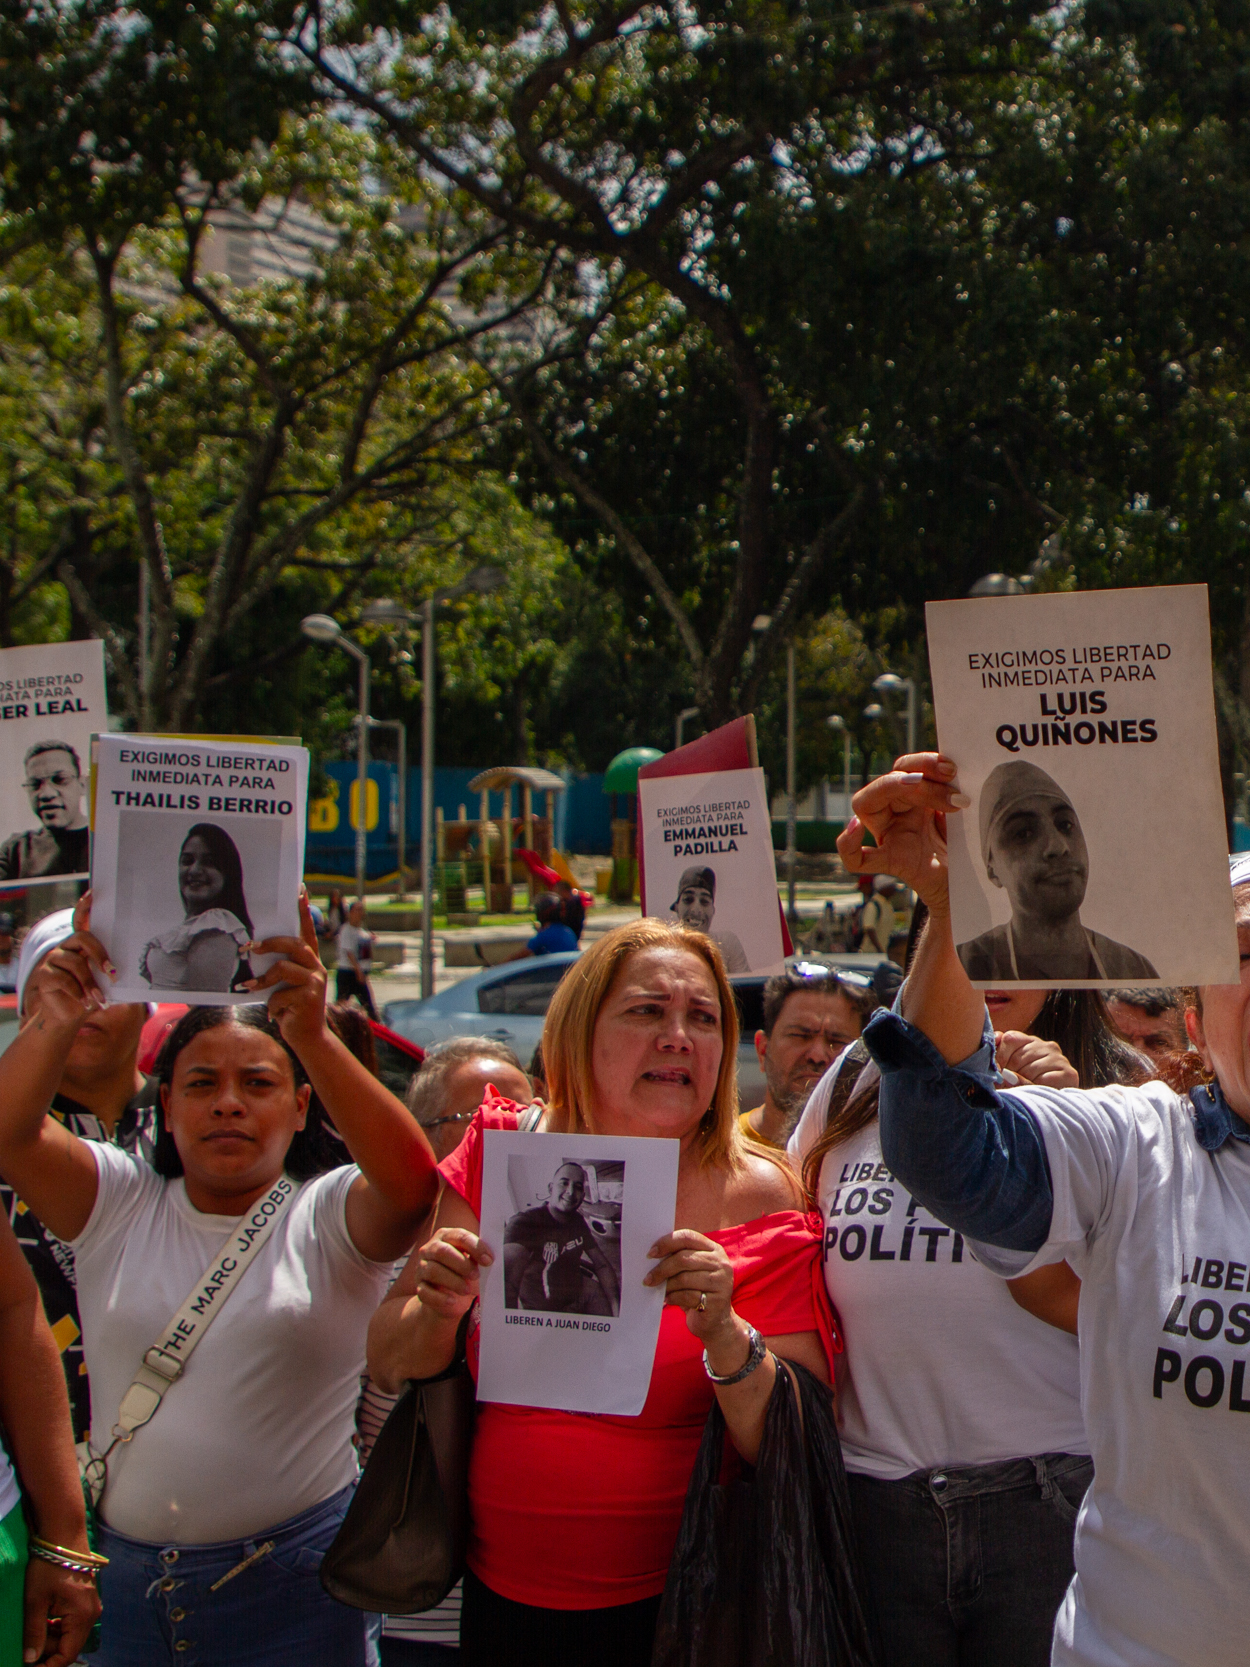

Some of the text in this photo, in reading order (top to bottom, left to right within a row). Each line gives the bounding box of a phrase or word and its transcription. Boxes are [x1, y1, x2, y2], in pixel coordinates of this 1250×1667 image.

[968, 643, 1172, 670] EXIGIMOS LIBERTAD
[16, 673, 84, 689] LIBERTAD
[981, 664, 1157, 688] INMEDIATA PARA
[34, 686, 74, 698] PARA
[1039, 690, 1108, 716] LUIS
[35, 698, 89, 716] LEAL
[995, 714, 1158, 753] QUIÑONES
[119, 750, 290, 772] EXIGIMOS LIBERTAD
[131, 769, 275, 790] INMEDIATA PARA
[111, 790, 293, 815] THAILIS BERRIO
[657, 800, 750, 818] EXIGIMOS LIBERTAD
[662, 811, 744, 827] INMEDIATA PARA
[663, 823, 748, 843] EMMANUEL
[673, 839, 738, 857] PADILLA
[838, 1162, 895, 1184] LIBE
[829, 1187, 895, 1217] LOS
[191, 1257, 238, 1315] MARC
[237, 1180, 293, 1252] JACOBS
[824, 1218, 978, 1263] POLÍTI
[505, 1314, 611, 1333] LIBEREN A JUAN DIEGO
